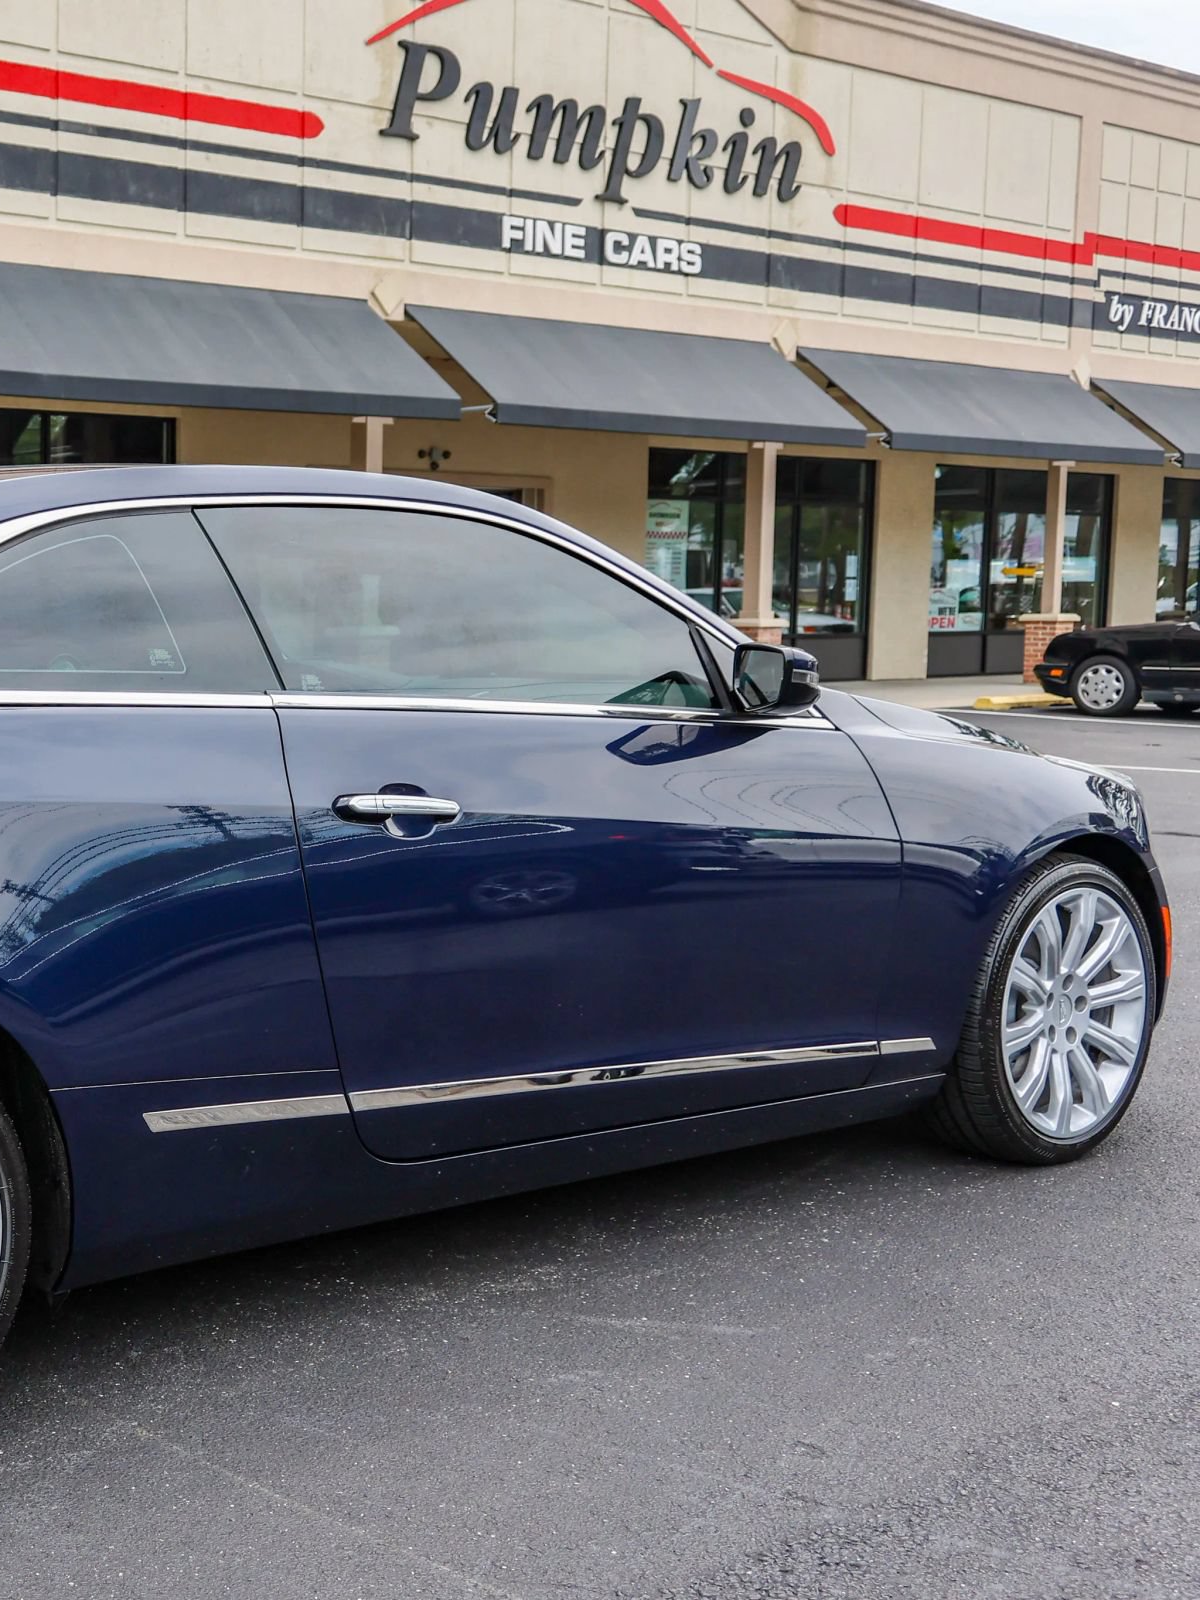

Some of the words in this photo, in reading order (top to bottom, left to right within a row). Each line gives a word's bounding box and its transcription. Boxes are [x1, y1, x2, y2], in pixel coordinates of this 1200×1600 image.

[379, 39, 802, 204] Pumpkin
[501, 215, 586, 259] FINE
[603, 231, 702, 275] CARS
[1108, 294, 1134, 332] by
[928, 617, 956, 629] PEN
